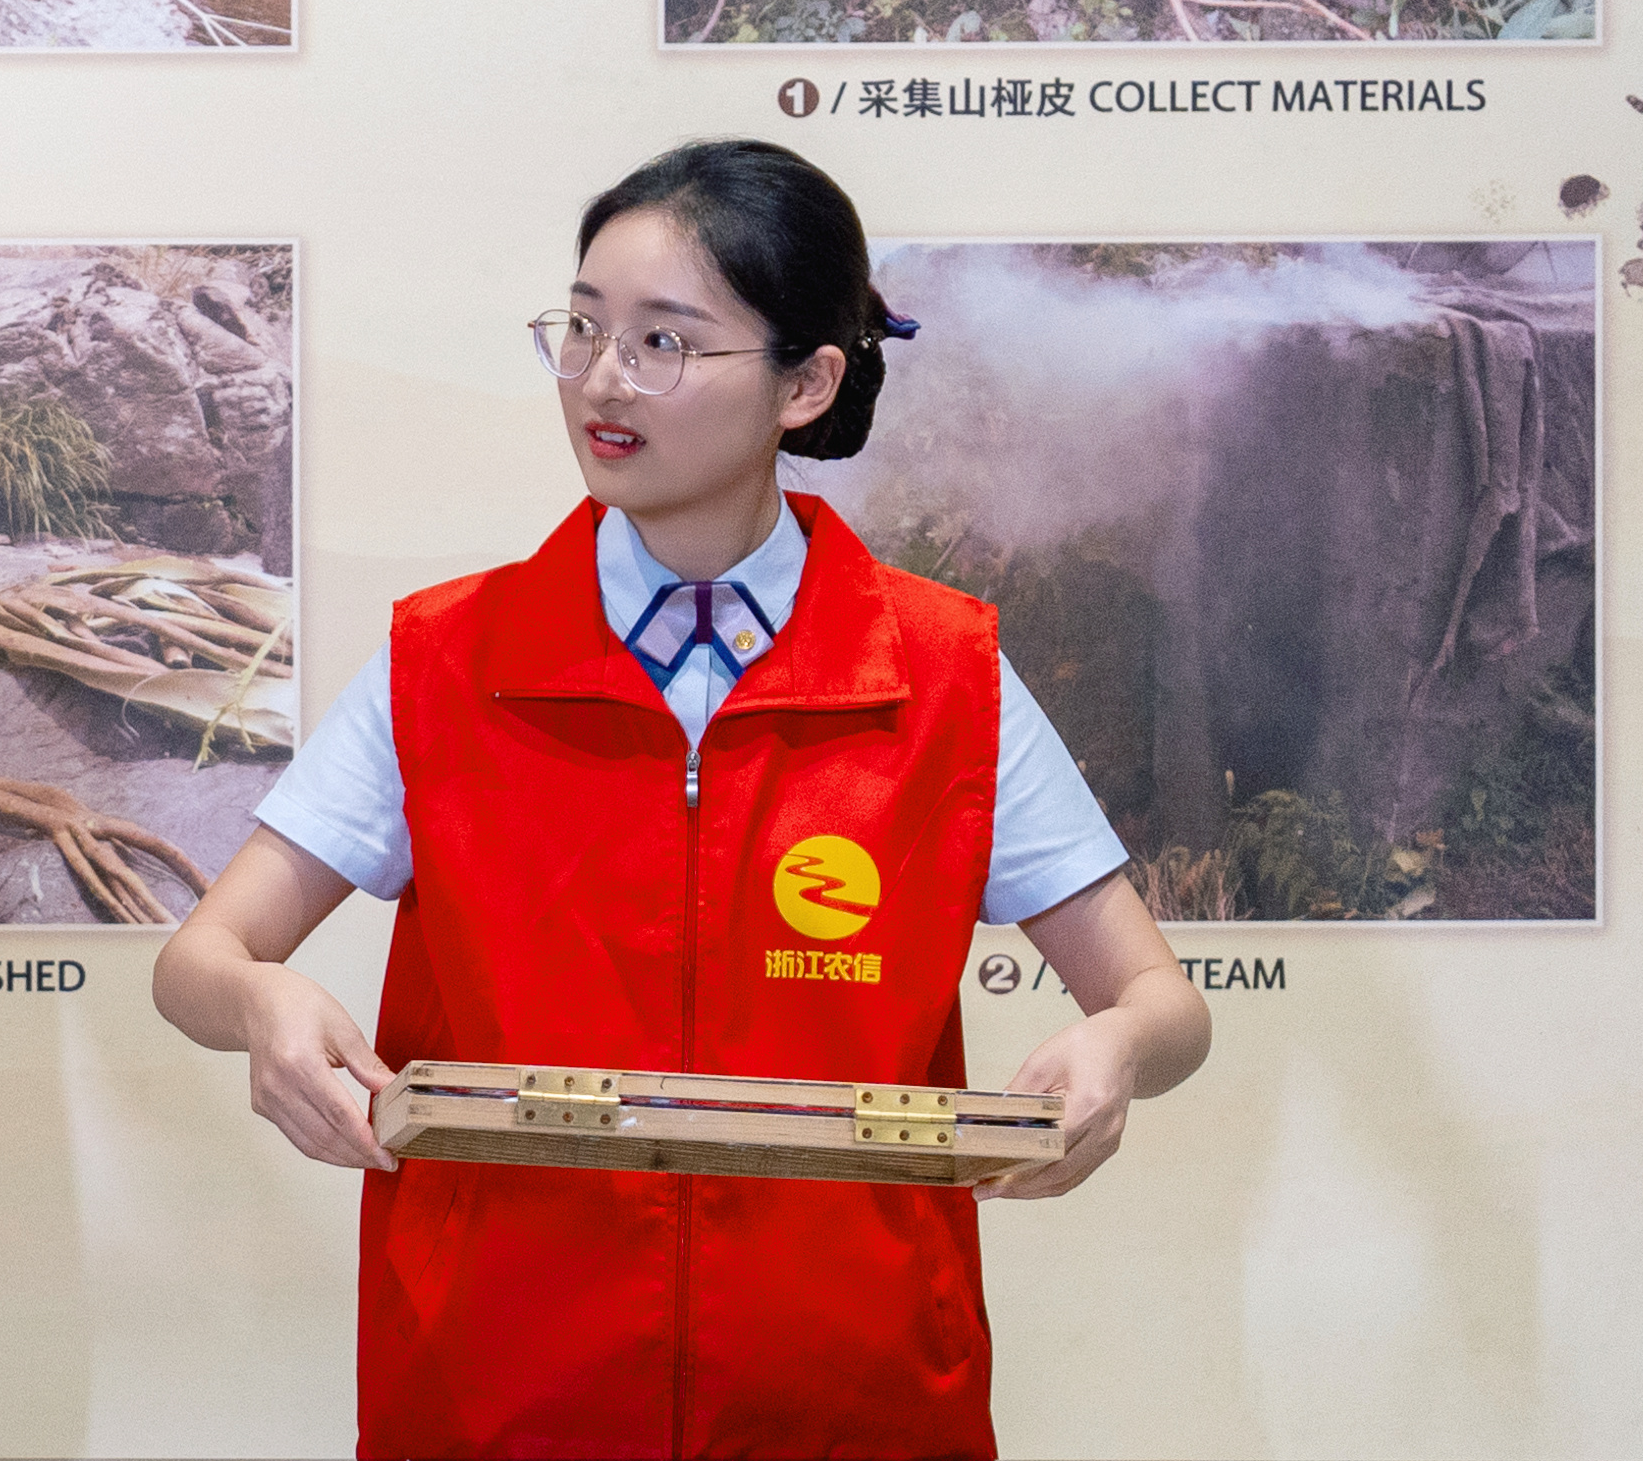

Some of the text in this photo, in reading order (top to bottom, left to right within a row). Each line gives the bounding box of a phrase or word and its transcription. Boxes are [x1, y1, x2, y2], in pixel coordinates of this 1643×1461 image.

[860, 77, 1076, 119] 采集山桠皮
[1089, 80, 1262, 113] COLLECT
[1272, 79, 1488, 113] MATERIALS
[765, 949, 882, 984] 浙江农信
[1178, 957, 1287, 991] TEAM
